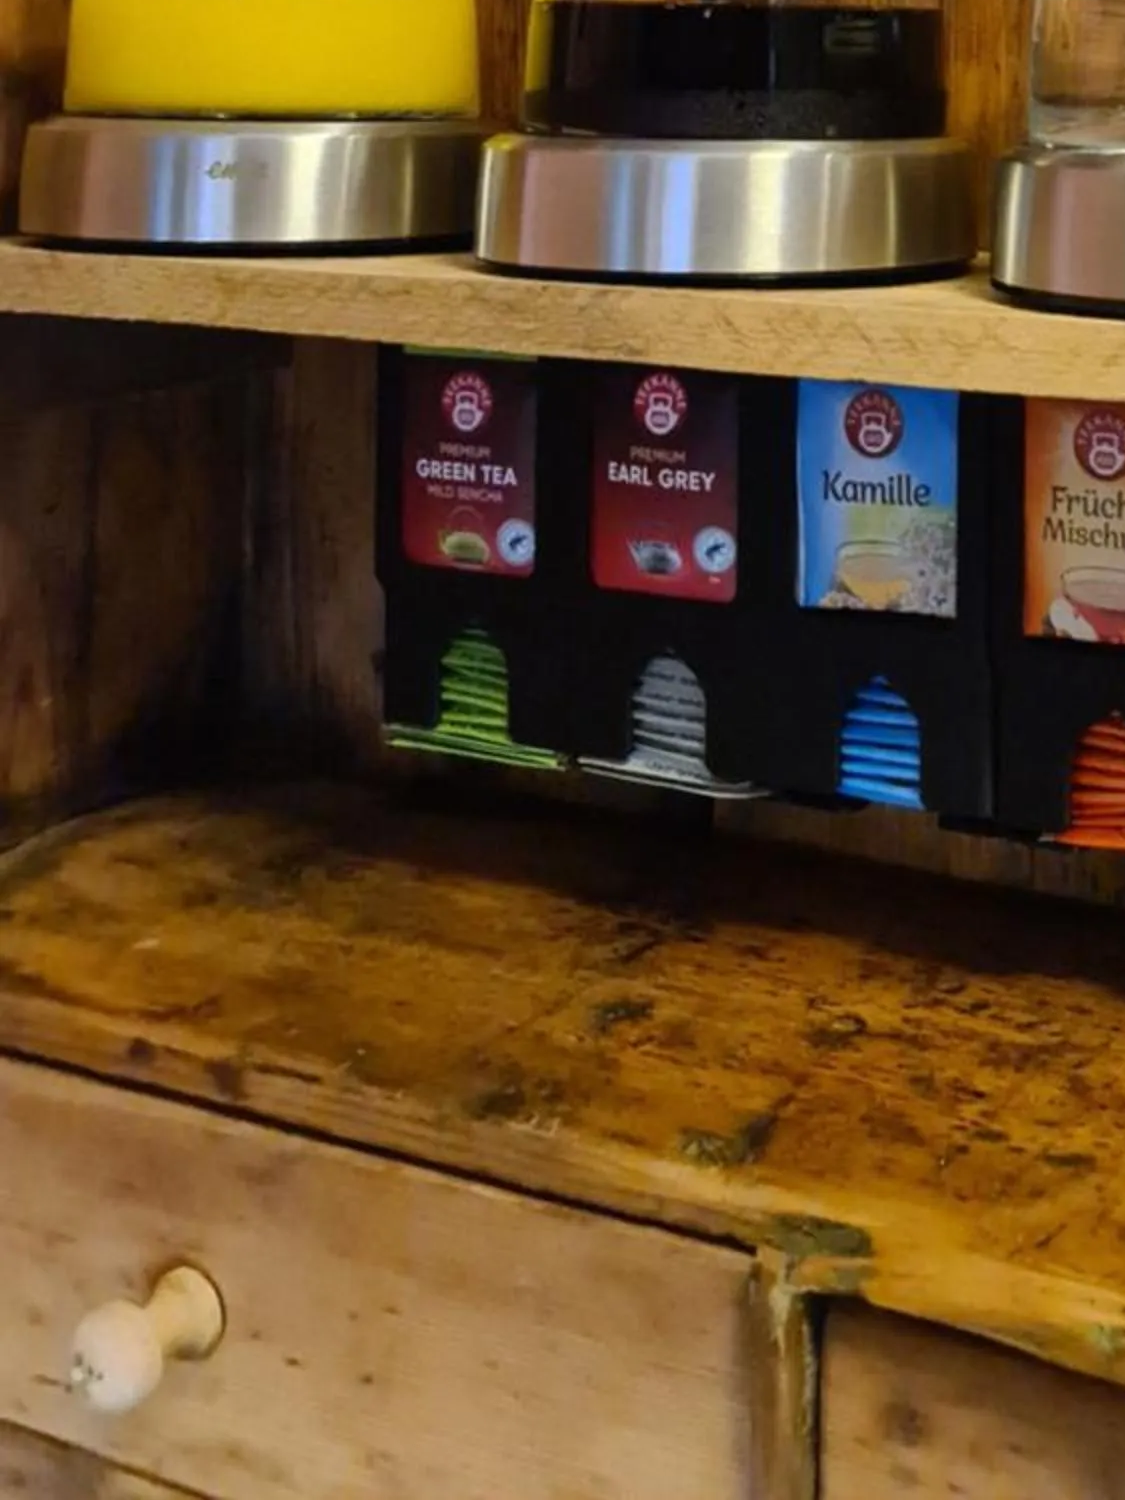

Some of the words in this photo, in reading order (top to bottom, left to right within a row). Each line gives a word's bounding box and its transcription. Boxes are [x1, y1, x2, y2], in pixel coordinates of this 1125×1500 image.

[416, 459, 476, 482] GREEN
[480, 465, 518, 486] TEA
[608, 461, 652, 486] EARL
[658, 468, 716, 492] GREY
[821, 469, 931, 507] Kamille
